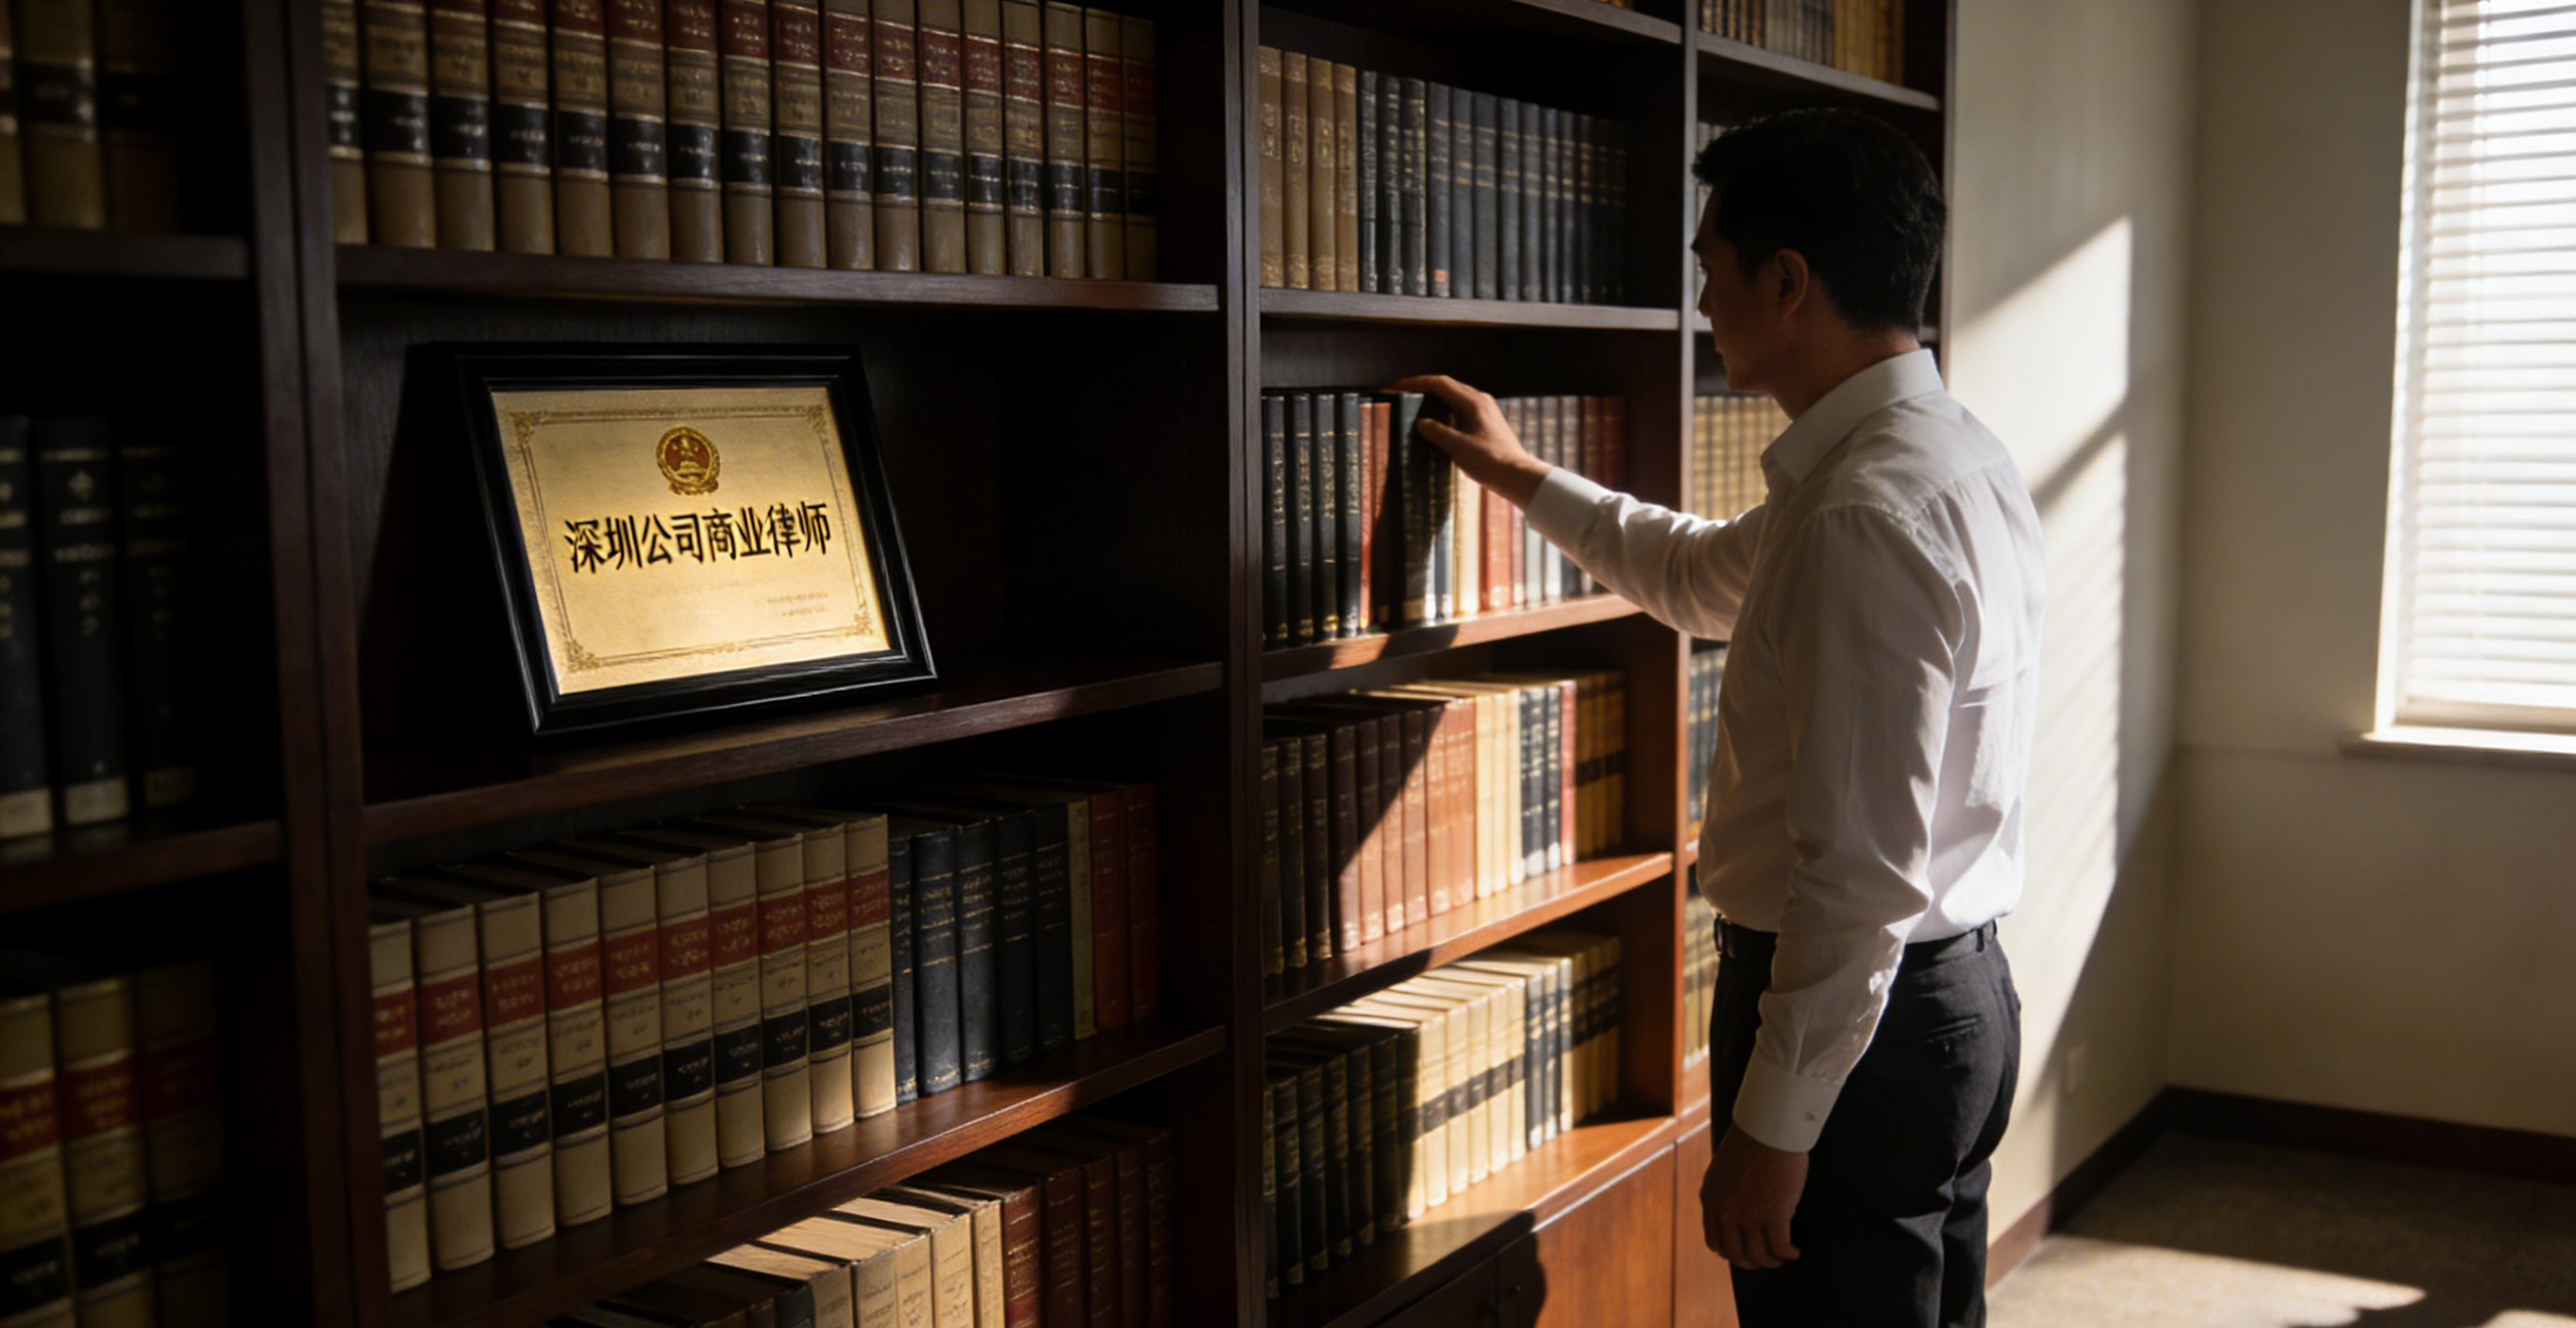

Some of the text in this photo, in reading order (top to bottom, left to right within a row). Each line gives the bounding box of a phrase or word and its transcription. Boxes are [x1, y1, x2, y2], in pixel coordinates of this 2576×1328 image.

[564, 501, 830, 573] 深圳公司商业律师
